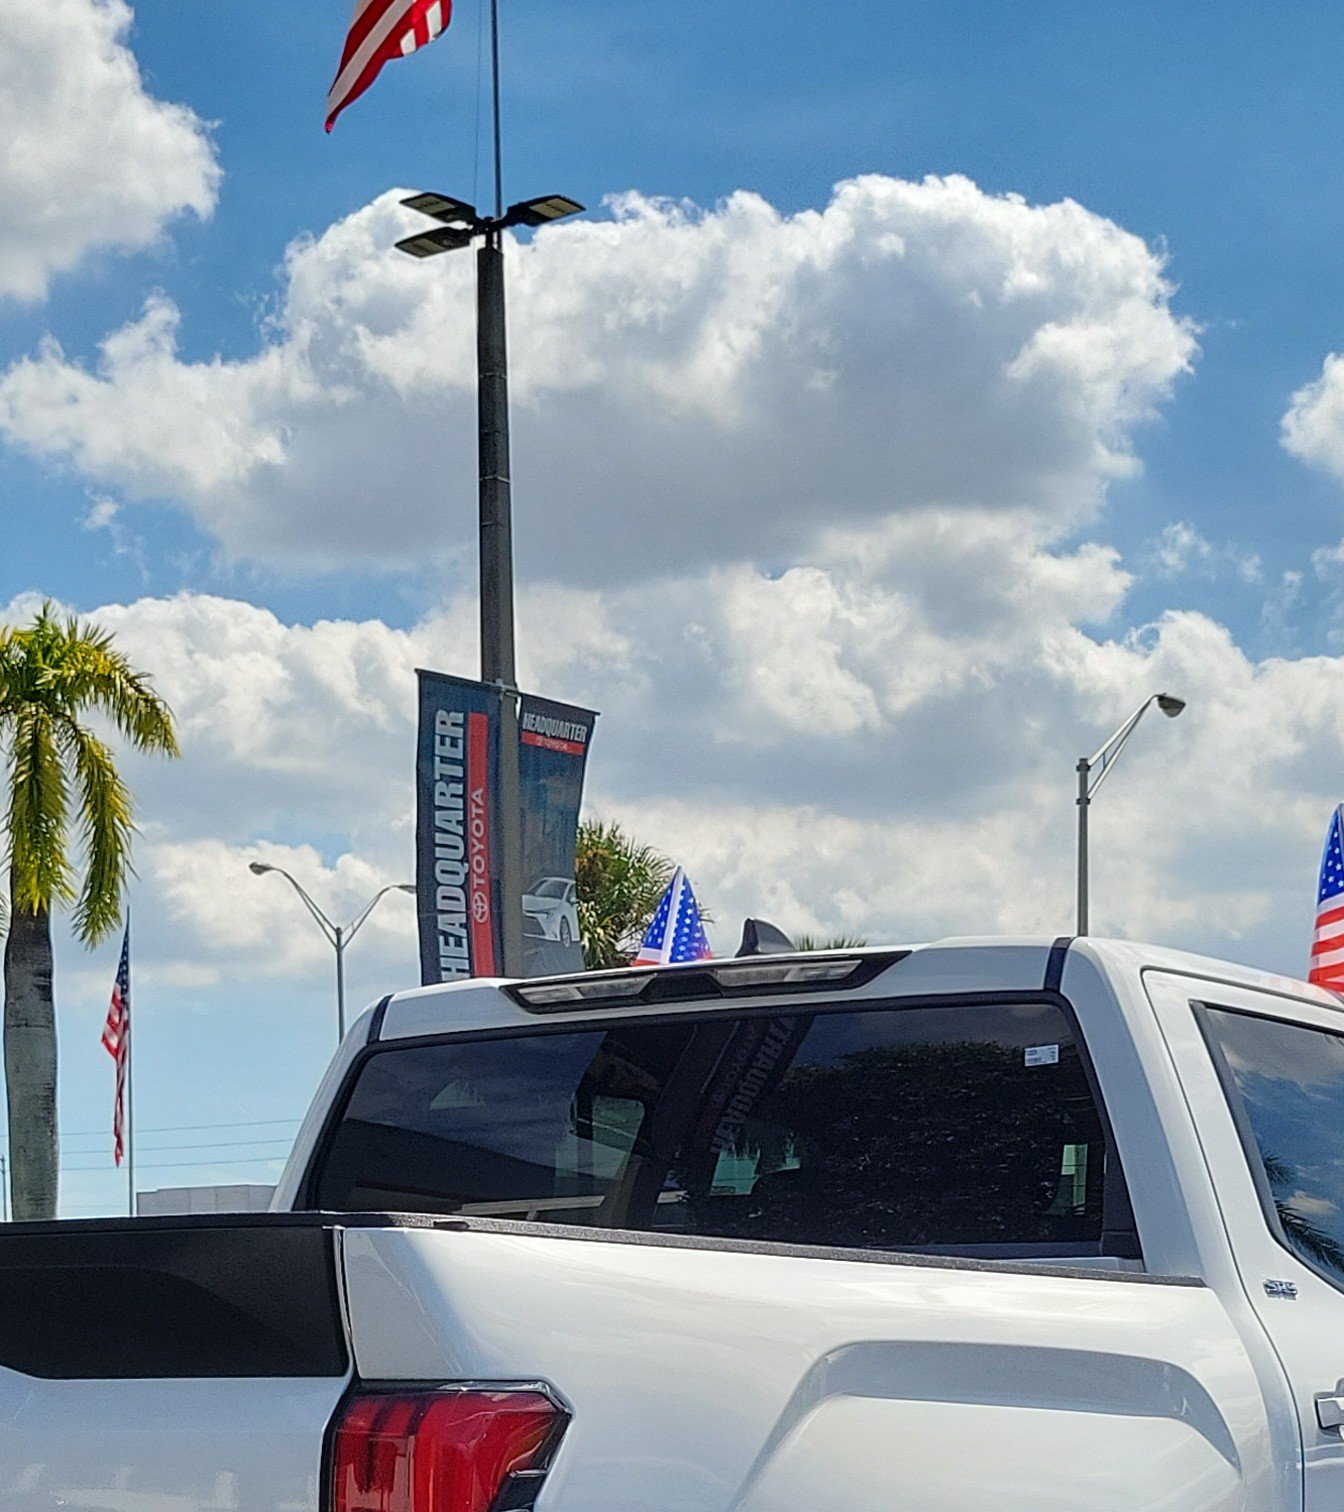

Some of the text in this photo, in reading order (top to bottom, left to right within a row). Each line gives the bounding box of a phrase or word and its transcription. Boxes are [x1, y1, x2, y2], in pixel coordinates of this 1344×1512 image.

[523, 712, 588, 743] HEADQUARTER
[434, 709, 471, 982] HEADQUARTER
[470, 788, 487, 889] TOYOTA
